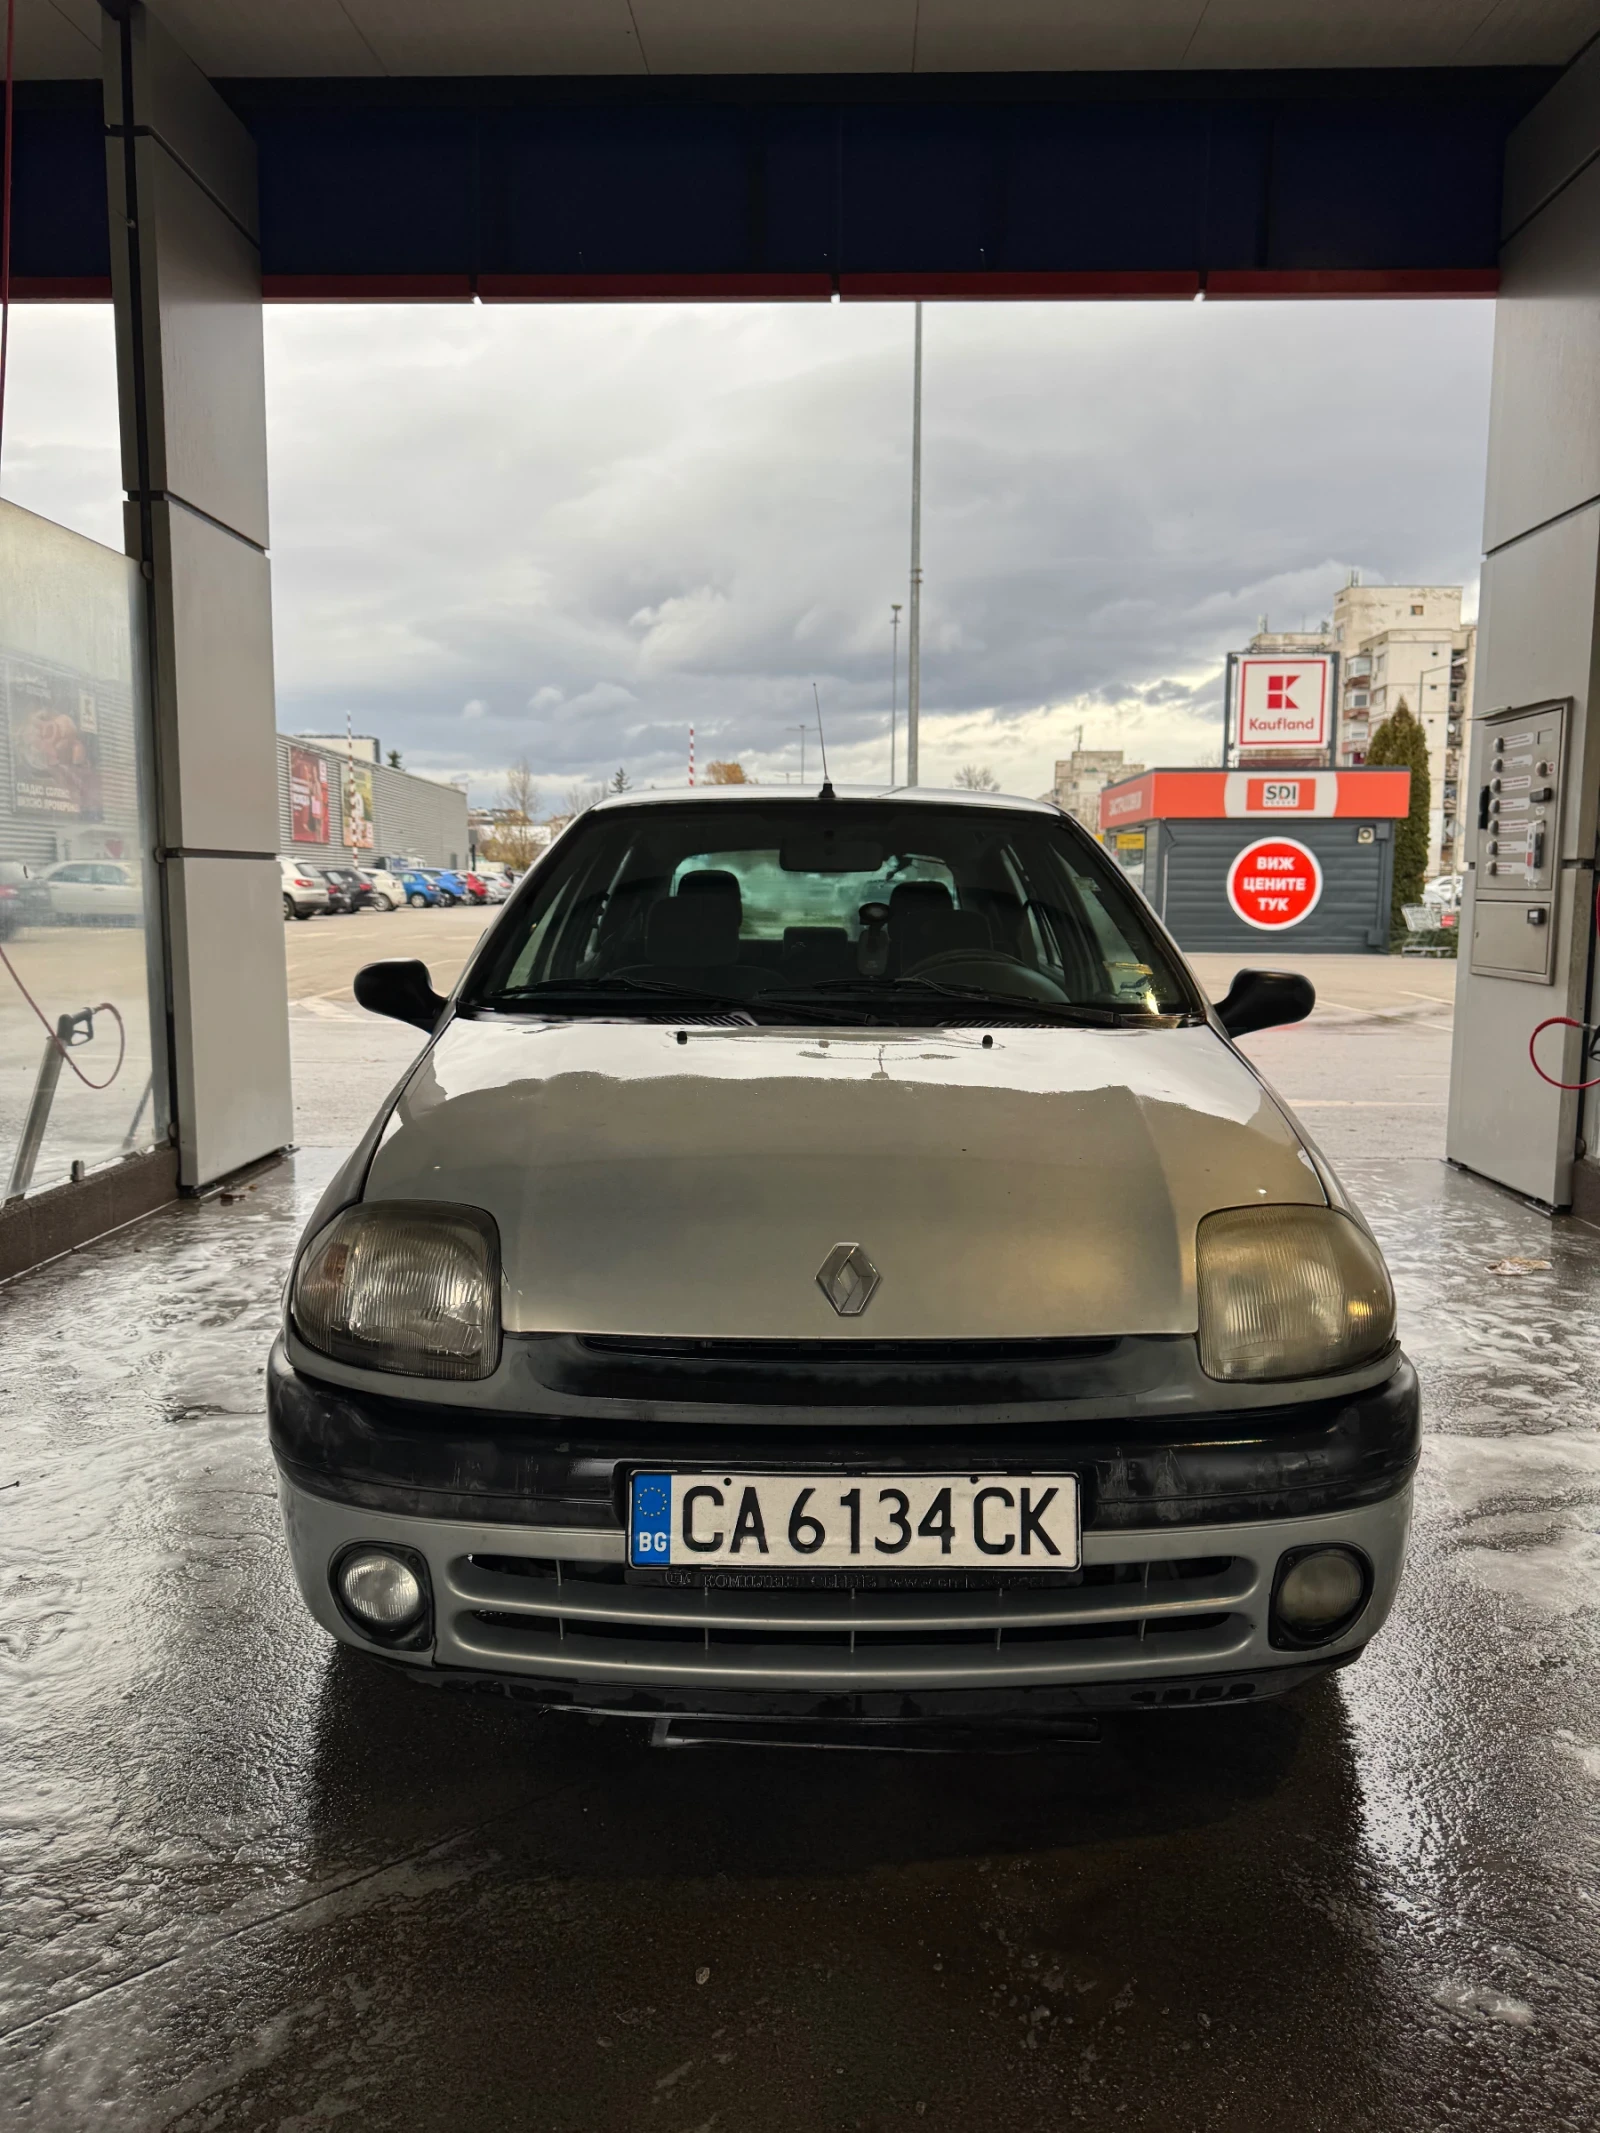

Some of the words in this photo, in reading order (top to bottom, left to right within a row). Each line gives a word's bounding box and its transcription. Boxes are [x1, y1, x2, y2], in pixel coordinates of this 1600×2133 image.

[1249, 717, 1315, 731] Kaufland
[1265, 785, 1296, 800] SDI
[1257, 856, 1295, 870] ВИЖ
[1243, 877, 1306, 893] ЦЕНИТЕ
[1257, 897, 1289, 911] ТУК
[788, 1487, 956, 1555] 6134
[638, 1533, 667, 1552] BG
